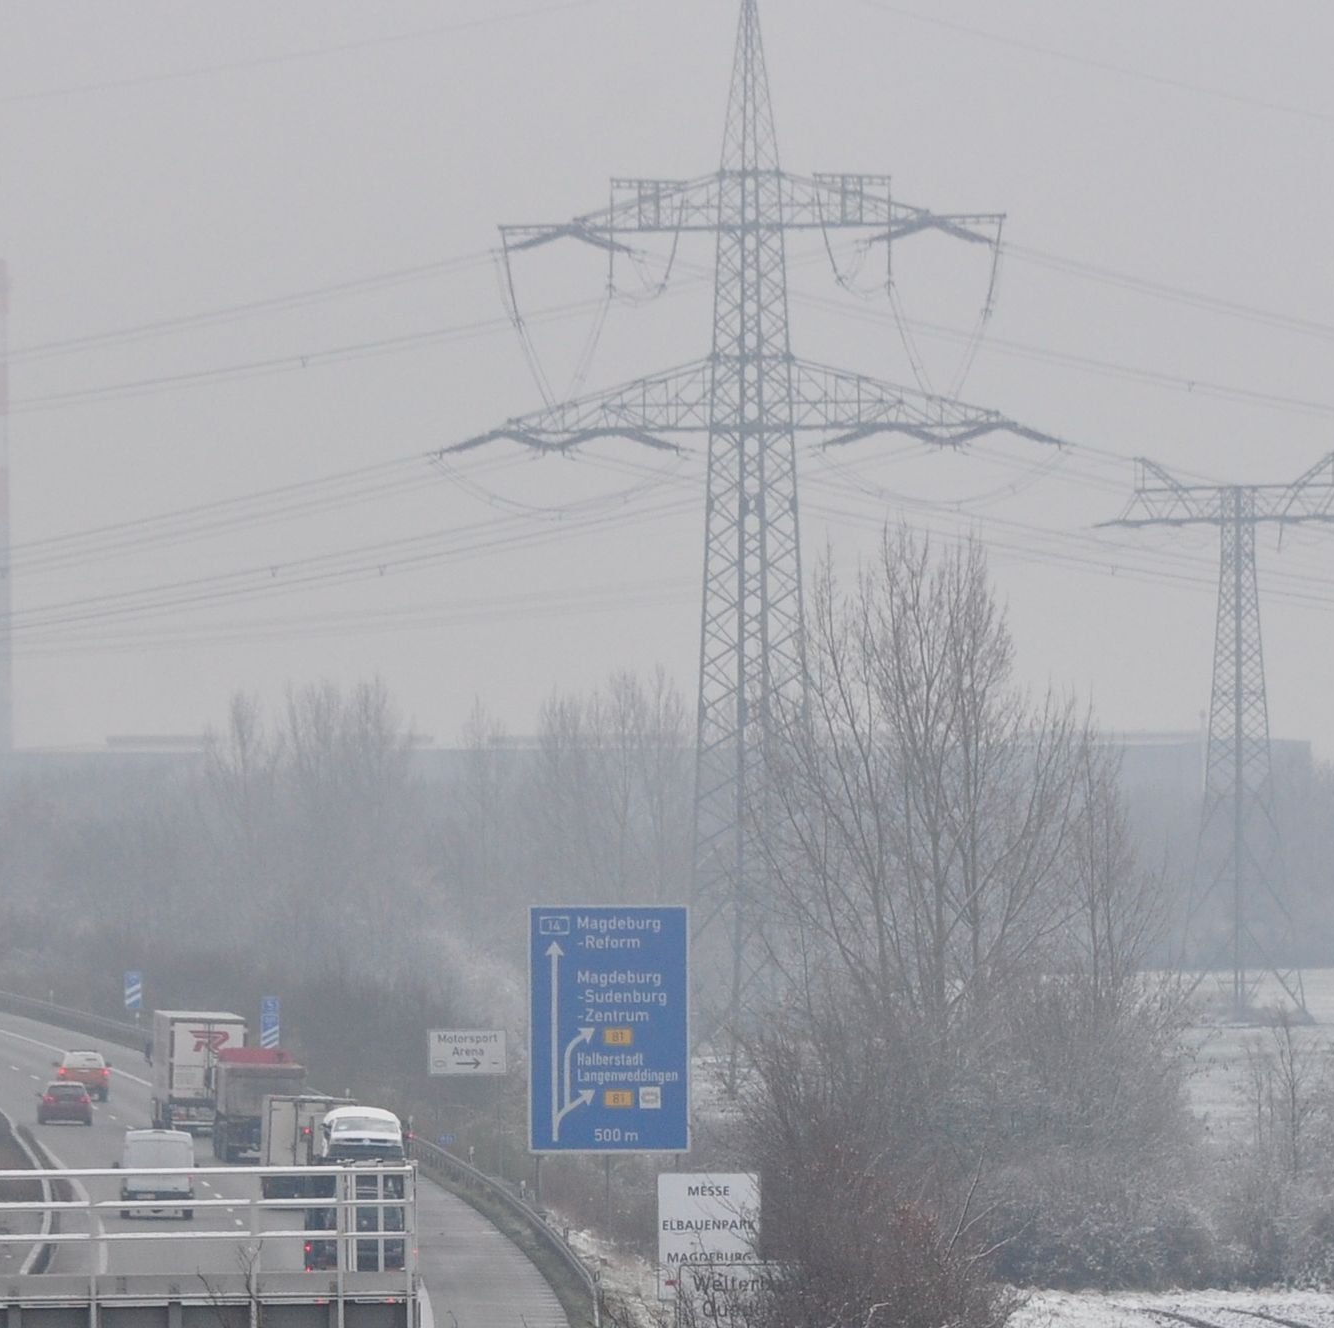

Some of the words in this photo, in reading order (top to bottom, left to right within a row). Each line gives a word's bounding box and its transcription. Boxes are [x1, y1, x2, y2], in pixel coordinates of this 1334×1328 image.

[577, 916, 661, 933] Magdeburg
[577, 934, 641, 949] -Reform
[577, 970, 662, 987] Magdeburg
[577, 988, 667, 1006] -Sudenburg
[577, 1007, 650, 1022] -Zentrum
[437, 1034, 498, 1045] Motorsport
[452, 1046, 484, 1057] Arena
[577, 1052, 644, 1066] Halberstadt
[577, 1068, 679, 1085] Langenweddingen
[594, 1128, 621, 1142] 500
[625, 1131, 639, 1142] m
[687, 1185, 730, 1197] MESSE
[662, 1219, 755, 1231] ELBAUENPARK
